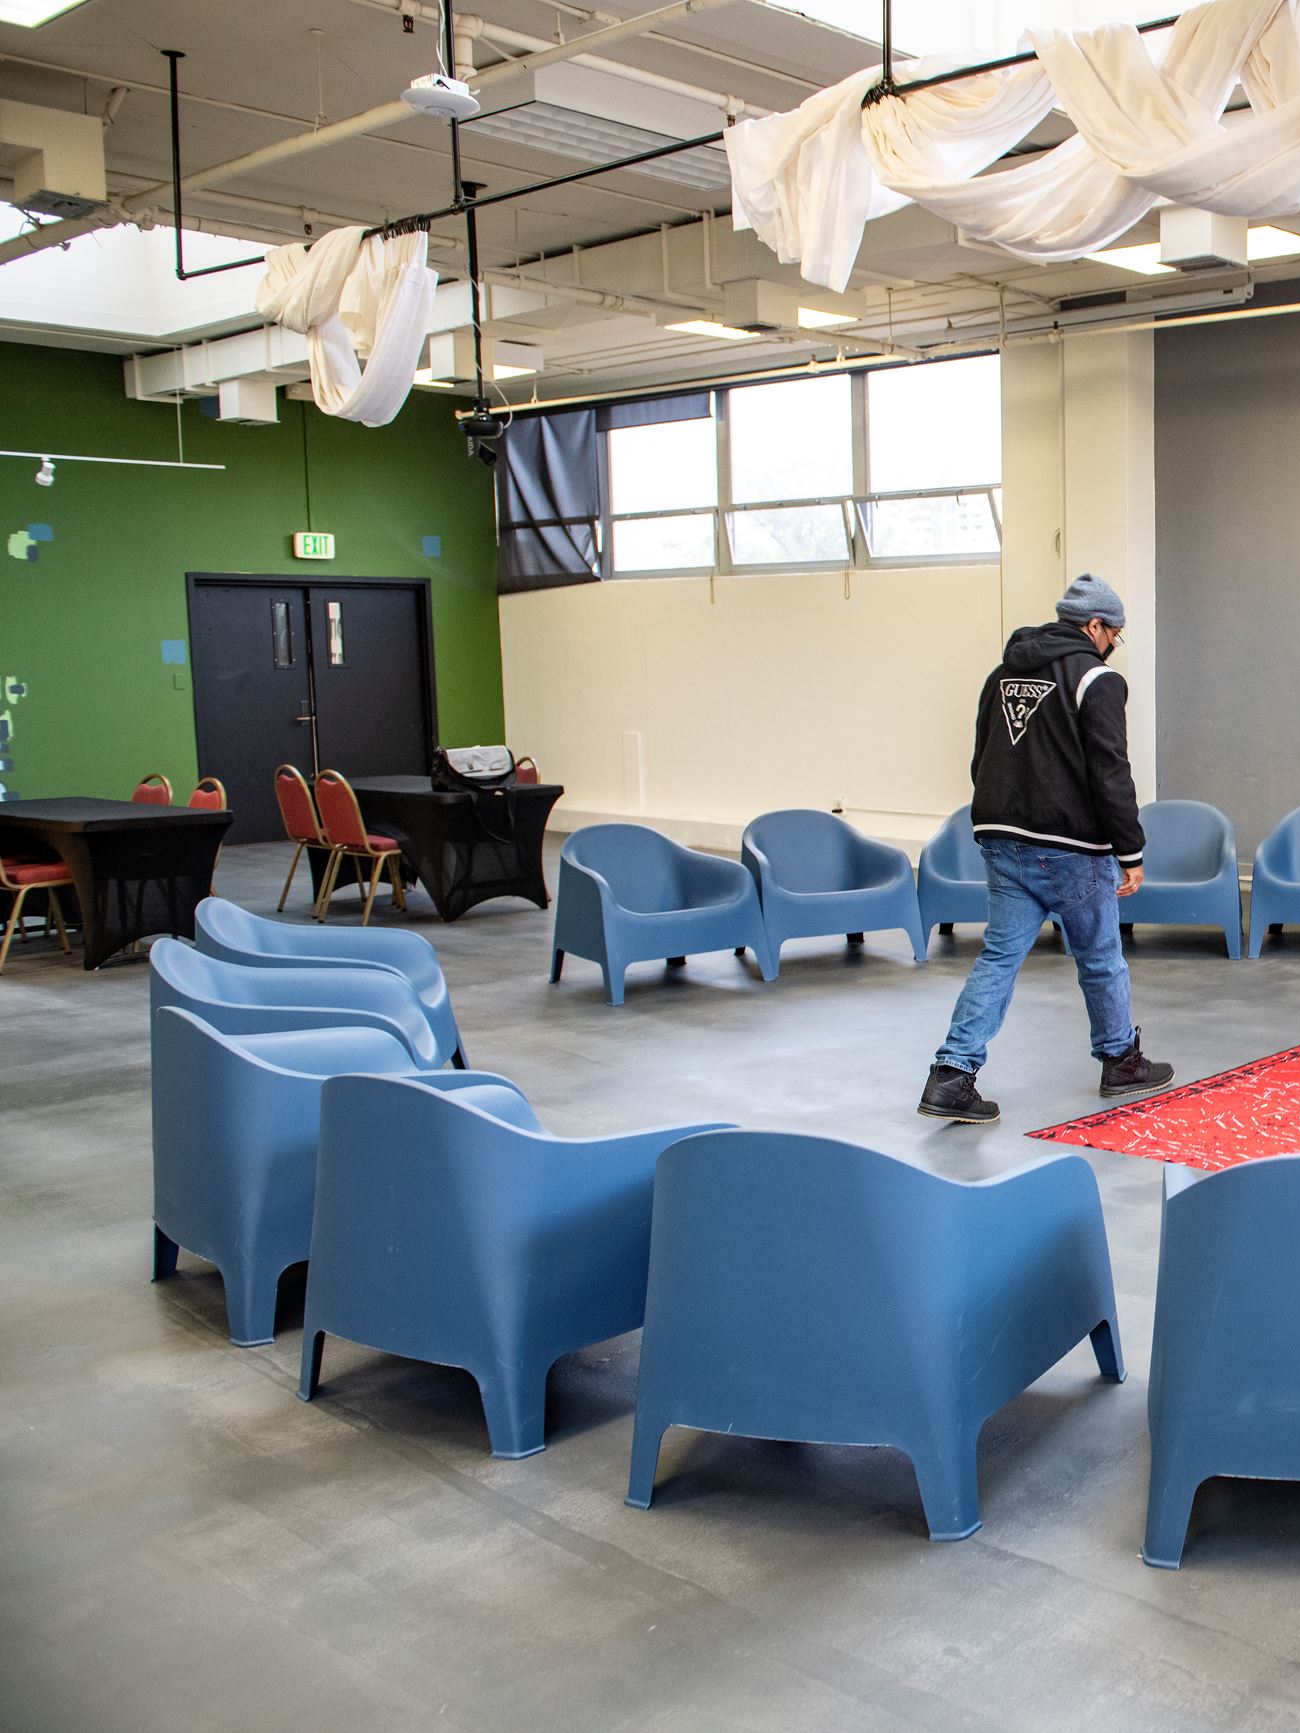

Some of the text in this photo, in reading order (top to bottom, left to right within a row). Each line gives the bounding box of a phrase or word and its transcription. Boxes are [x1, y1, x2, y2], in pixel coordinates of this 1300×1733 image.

[303, 534, 329, 555] EXIT
[1005, 683, 1042, 698] GUESS
[1015, 703, 1027, 720] ?
